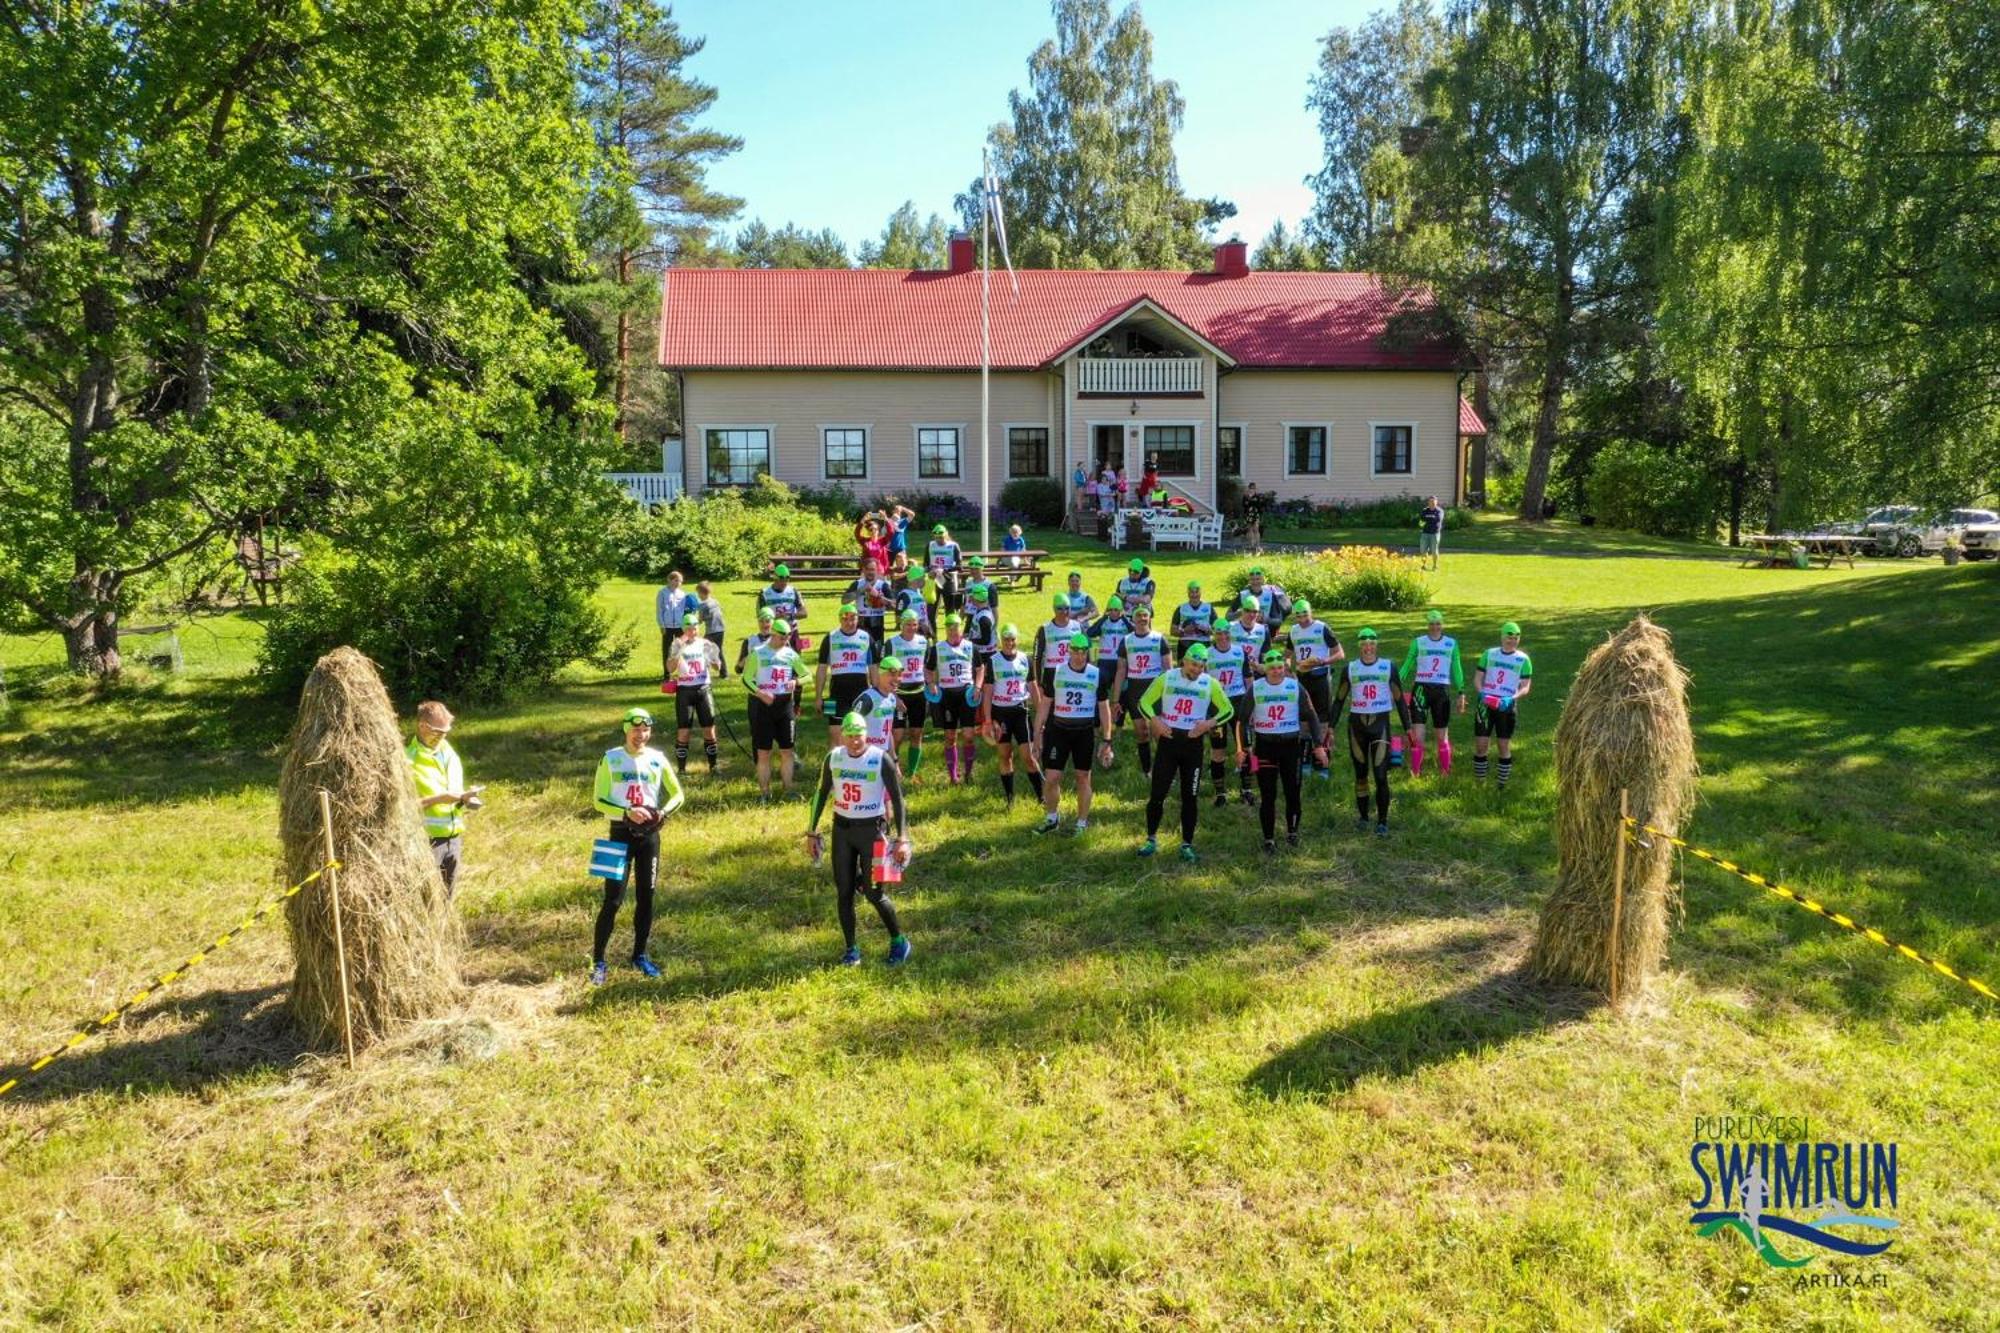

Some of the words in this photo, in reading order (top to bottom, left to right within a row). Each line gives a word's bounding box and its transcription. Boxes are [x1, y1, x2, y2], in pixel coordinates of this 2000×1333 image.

[949, 663, 963, 677] 50
[1065, 691, 1082, 705] 23
[1362, 684, 1377, 700] 46
[1174, 698, 1193, 716] 48
[1268, 704, 1286, 720] 42
[842, 782, 862, 803] 35
